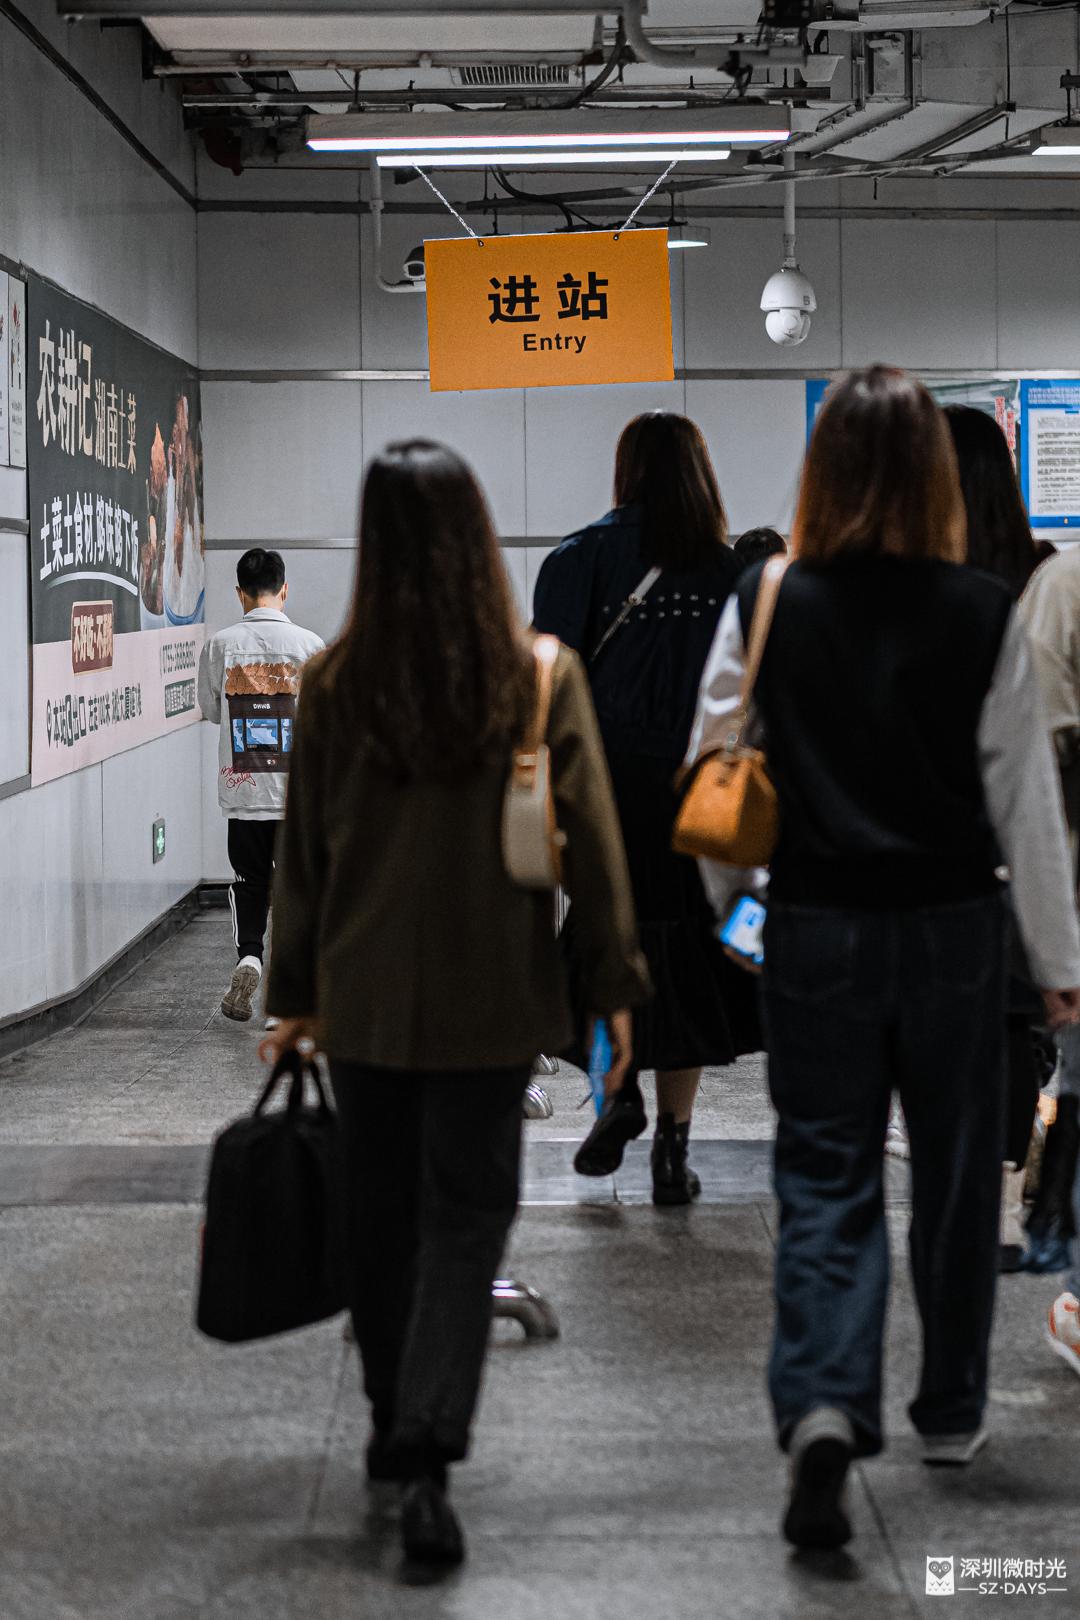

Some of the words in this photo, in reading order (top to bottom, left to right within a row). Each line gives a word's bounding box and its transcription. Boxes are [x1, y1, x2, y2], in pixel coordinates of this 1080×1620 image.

[488, 271, 608, 324] 进站
[523, 333, 587, 354] Entry
[37, 319, 93, 457] 农耕记
[94, 378, 136, 474] 湖南土菜
